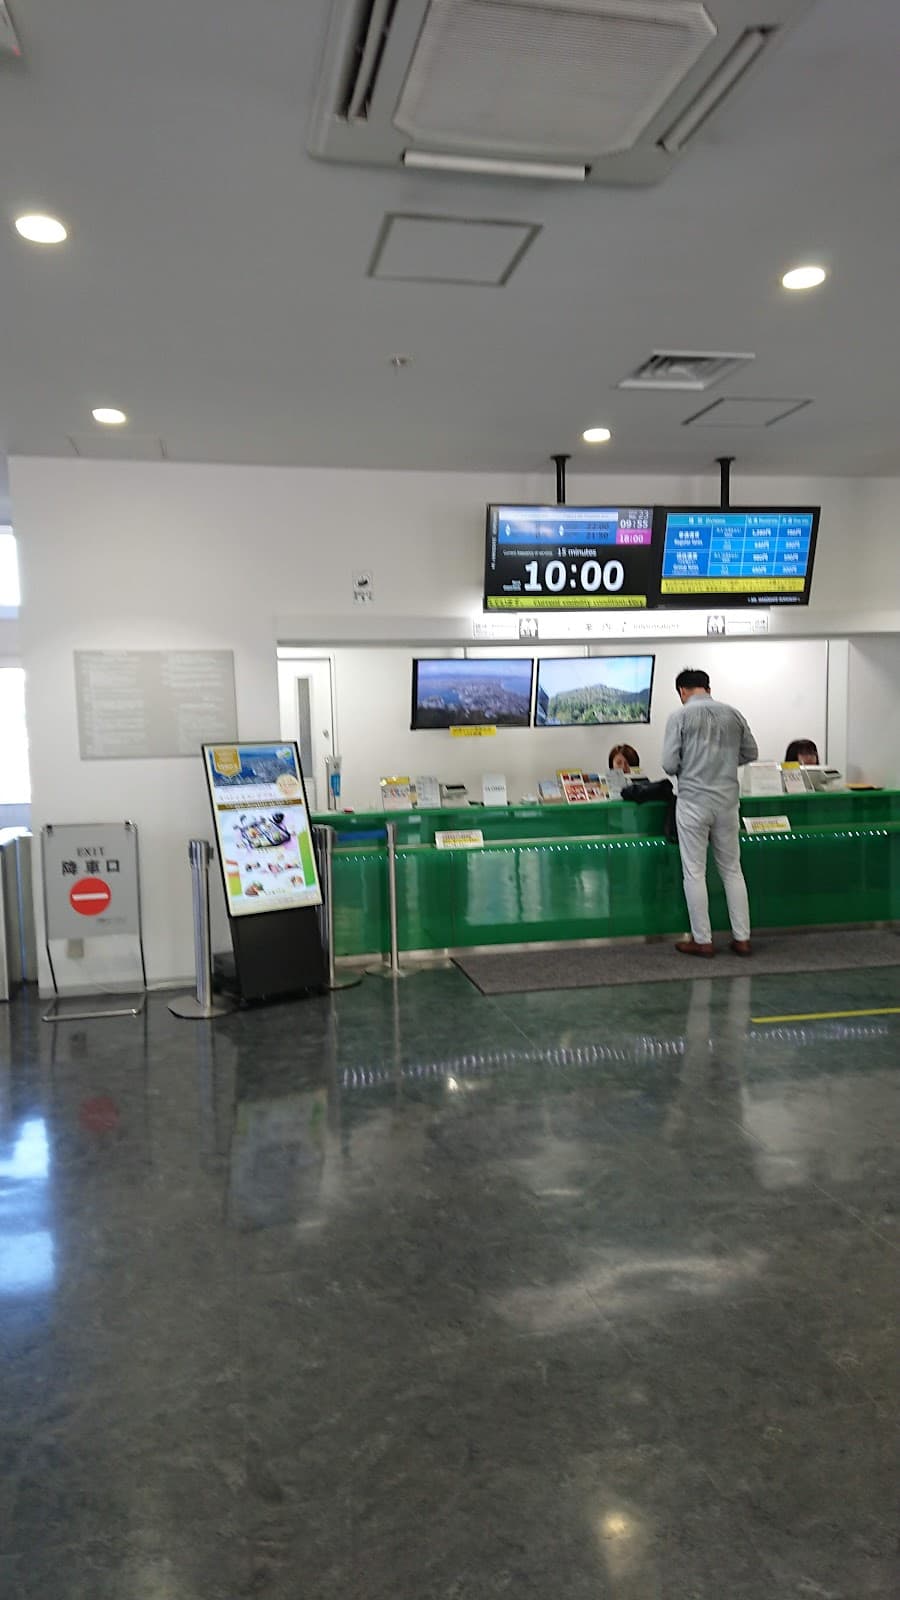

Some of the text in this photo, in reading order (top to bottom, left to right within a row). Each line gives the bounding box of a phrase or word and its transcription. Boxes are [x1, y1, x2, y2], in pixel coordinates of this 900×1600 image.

[568, 547, 597, 557] minutes
[523, 559, 625, 592] 10:00
[76, 846, 105, 857] EXIT
[61, 859, 120, 876] 降車口
